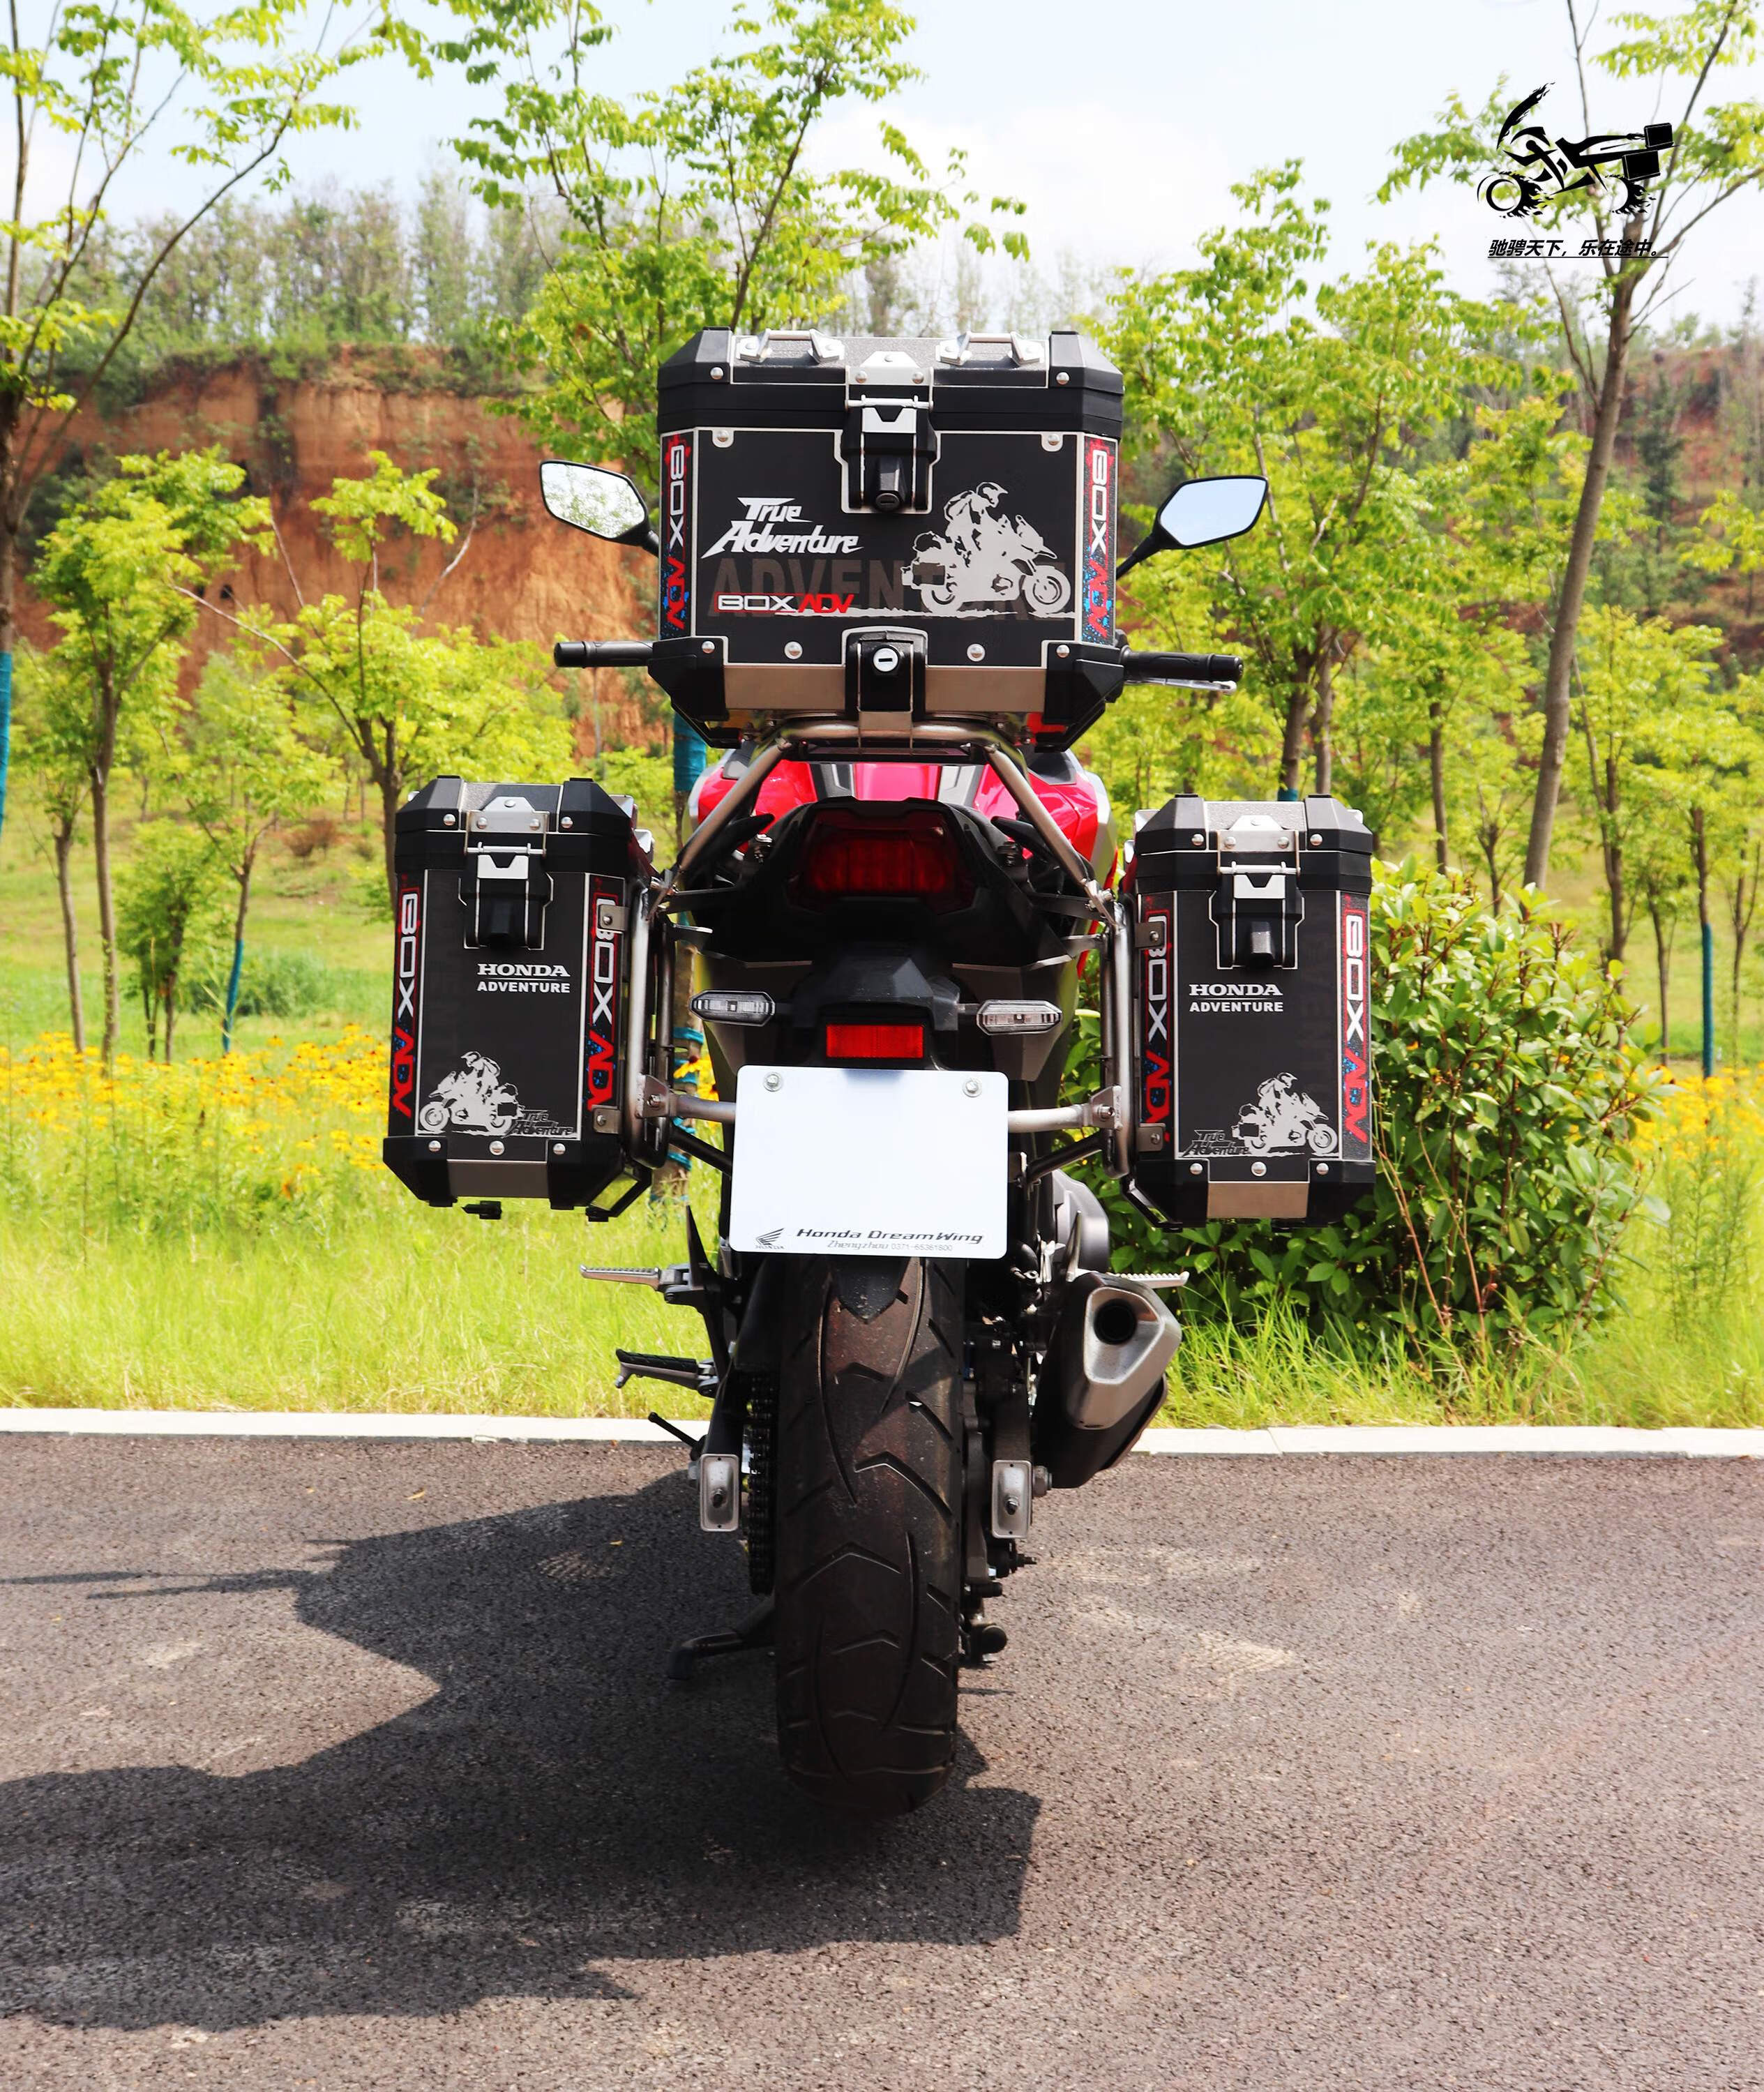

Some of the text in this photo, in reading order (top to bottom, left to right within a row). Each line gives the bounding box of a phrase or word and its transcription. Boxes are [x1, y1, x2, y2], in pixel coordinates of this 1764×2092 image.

[737, 497, 813, 522] True
[700, 520, 864, 559] Adventure
[477, 963, 571, 977] HONDA
[477, 981, 571, 993] ADVENTURE
[1189, 984, 1283, 997] HONDA
[1189, 1002, 1283, 1013] ADVENTURE
[796, 1228, 863, 1239] Honda
[827, 1240, 889, 1251] Zhengzhou
